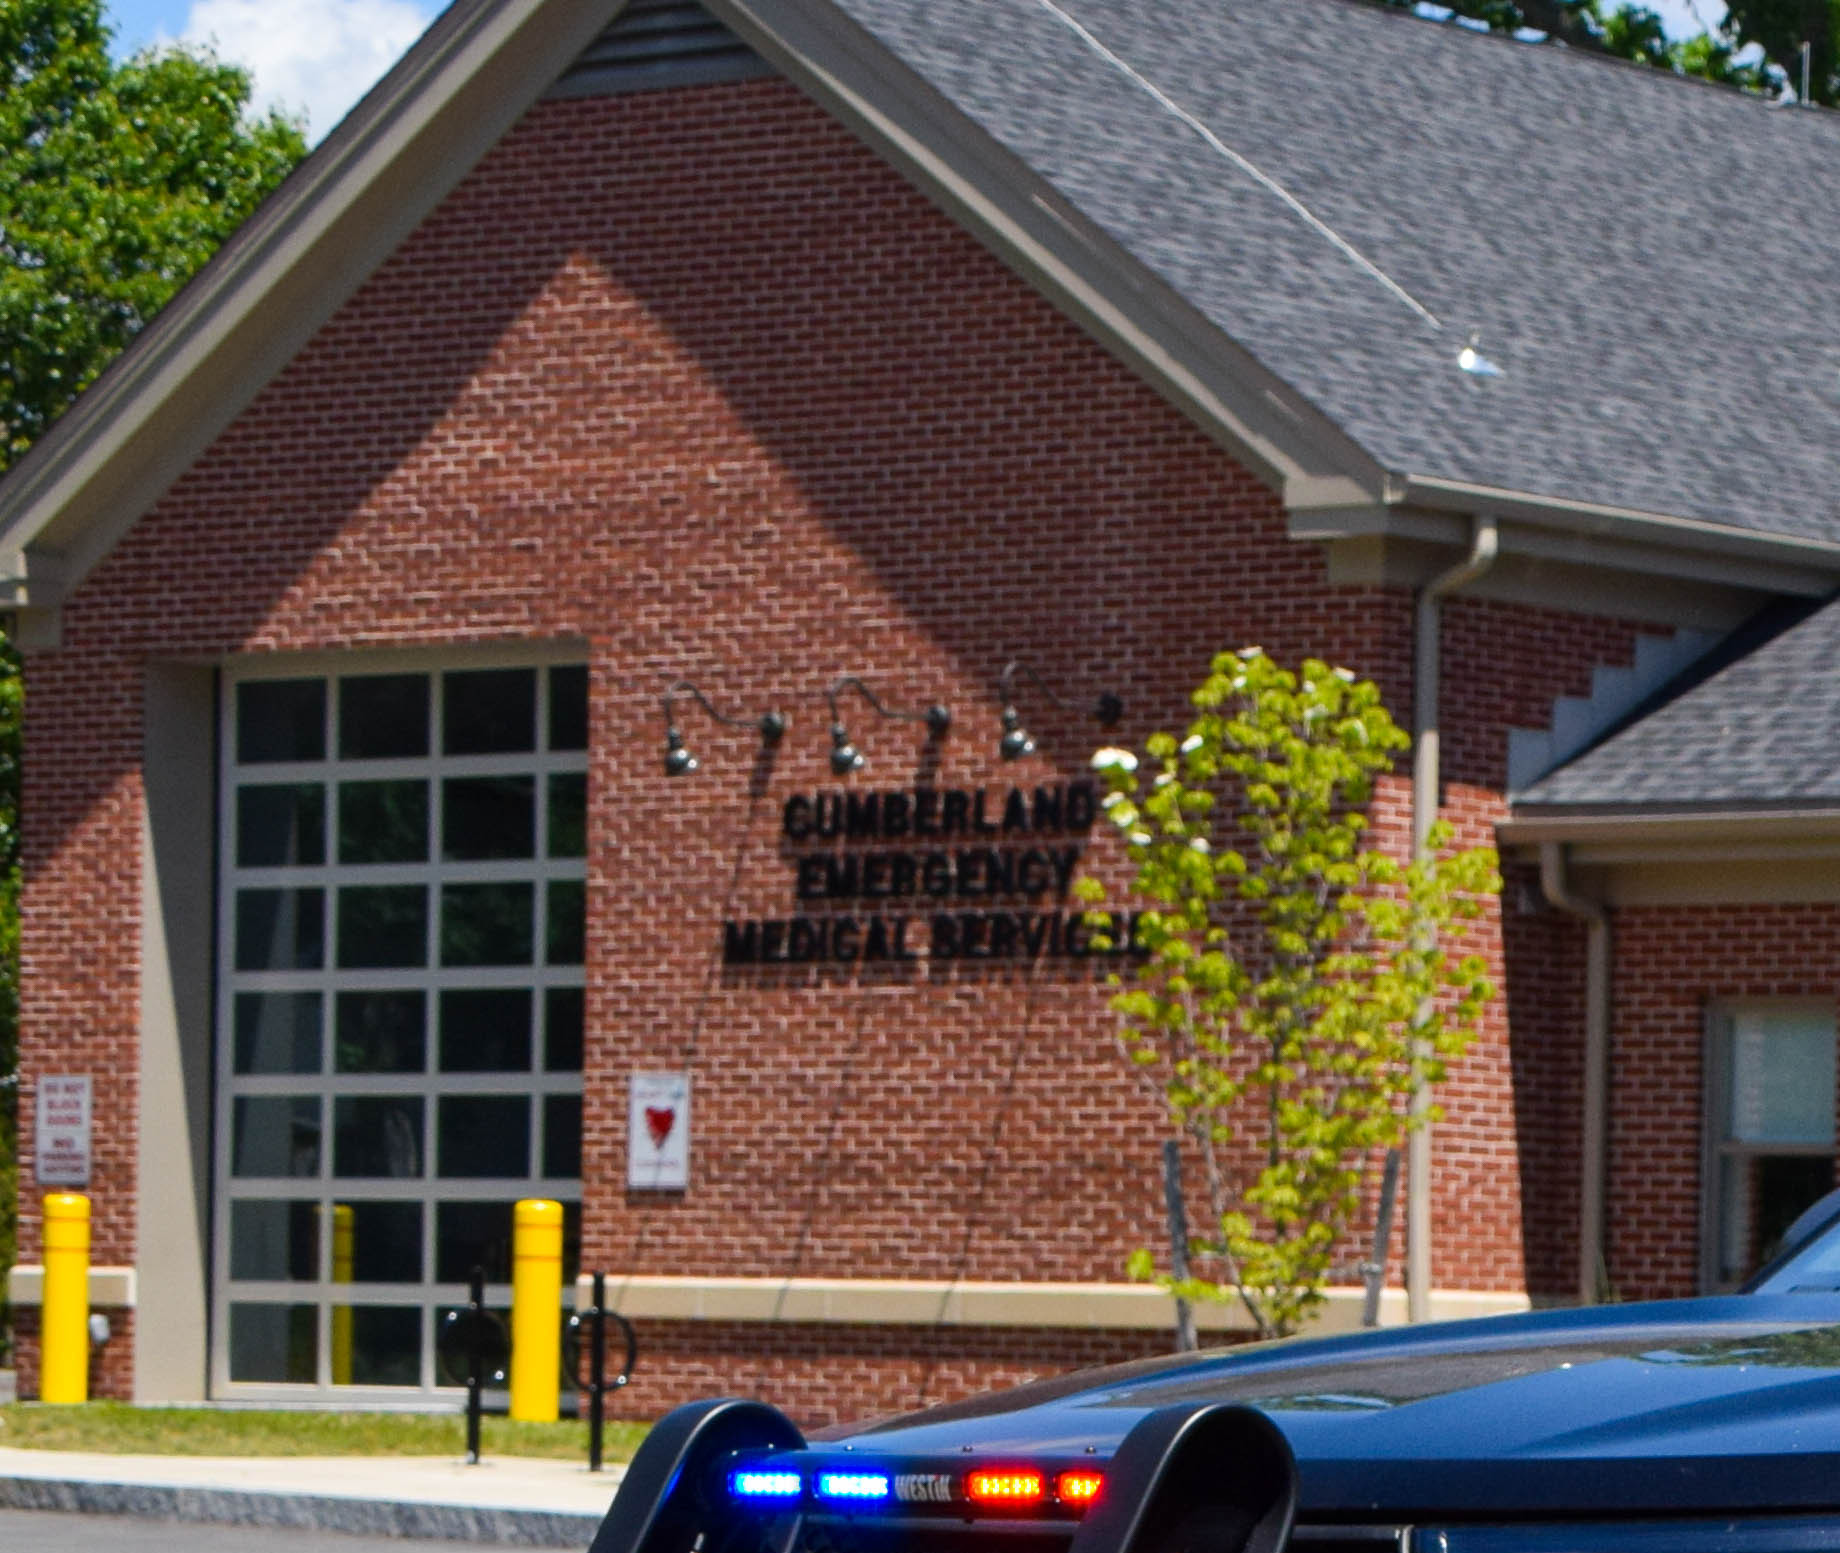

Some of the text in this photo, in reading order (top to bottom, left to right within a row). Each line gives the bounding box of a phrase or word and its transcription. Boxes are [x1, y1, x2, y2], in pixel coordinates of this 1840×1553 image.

[784, 783, 1099, 838] CUMBERLAND
[797, 846, 1080, 899] EMERGENCY
[724, 916, 928, 963] MEDICAL
